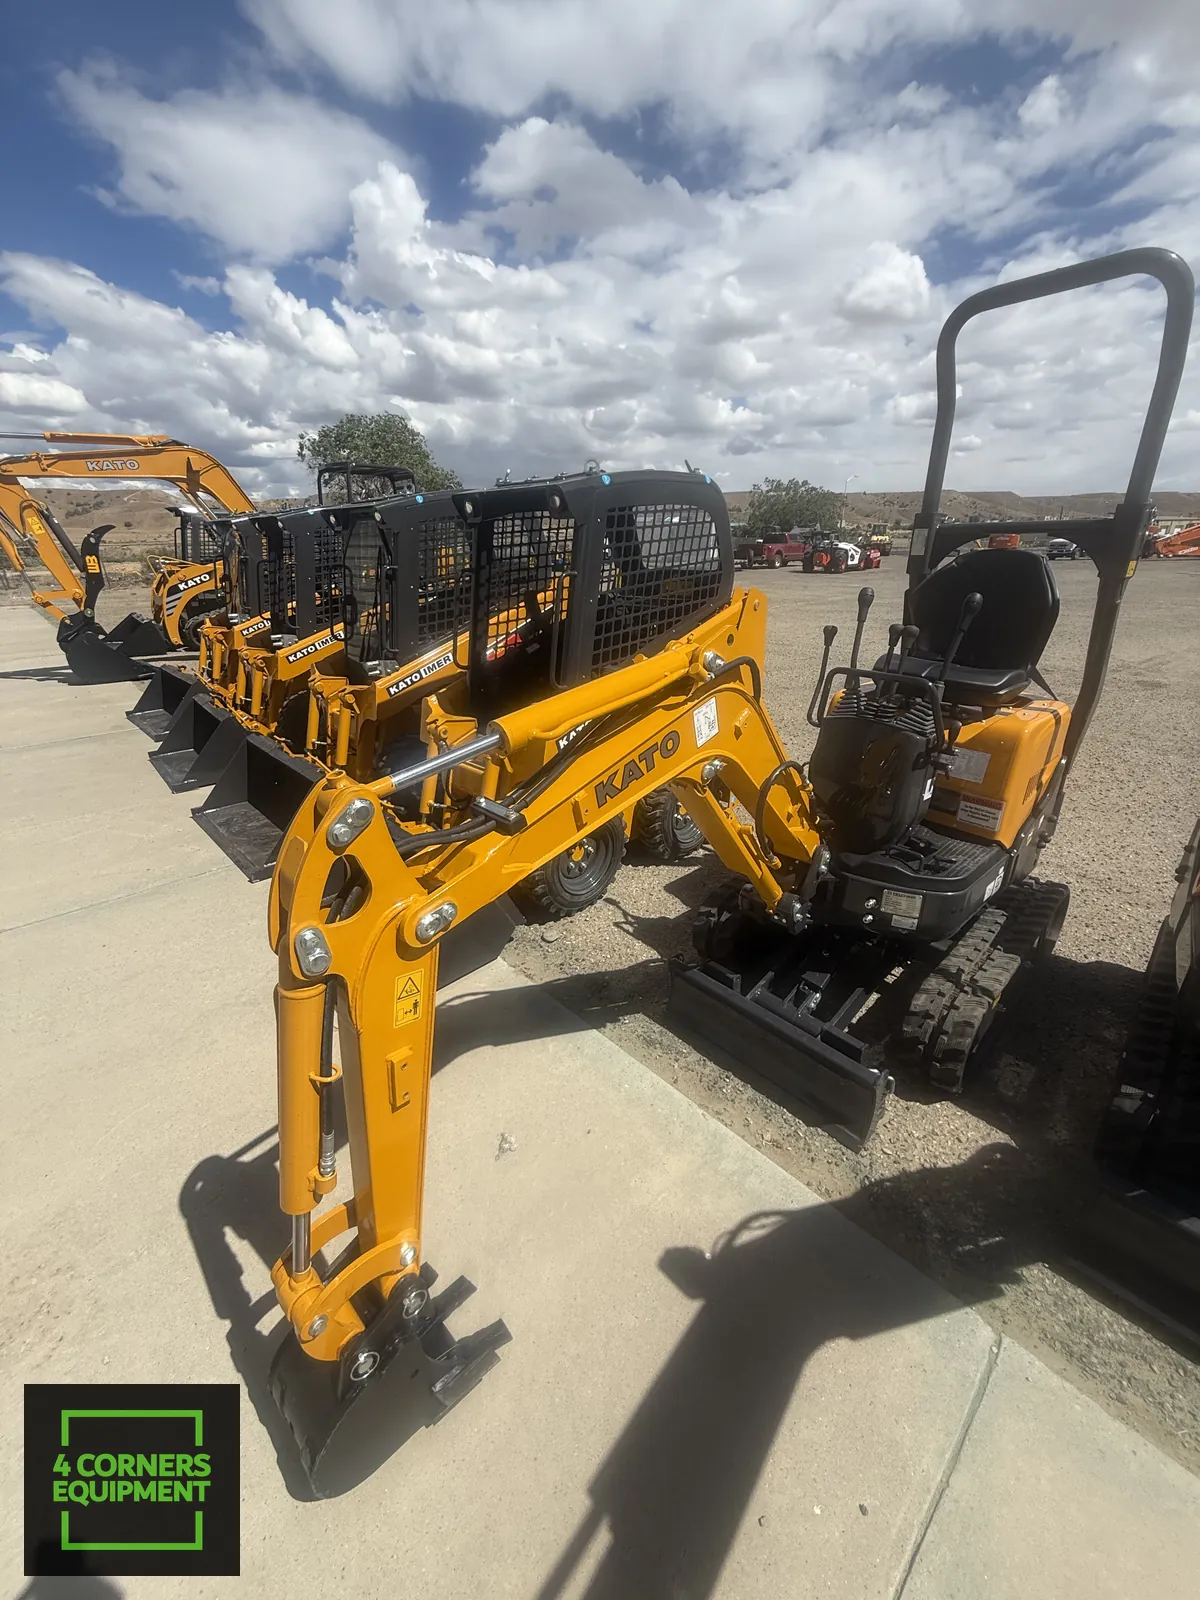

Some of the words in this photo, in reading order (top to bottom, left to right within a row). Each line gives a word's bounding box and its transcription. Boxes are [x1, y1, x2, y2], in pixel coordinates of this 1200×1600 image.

[86, 459, 139, 471] KATO
[178, 573, 210, 591] KATO
[241, 622, 264, 636] KATO
[287, 645, 315, 662] KATO
[317, 632, 343, 649] IMER
[389, 673, 420, 695] KATO
[423, 655, 451, 676] IMER
[558, 718, 593, 750] KAT
[594, 730, 680, 809] KATO
